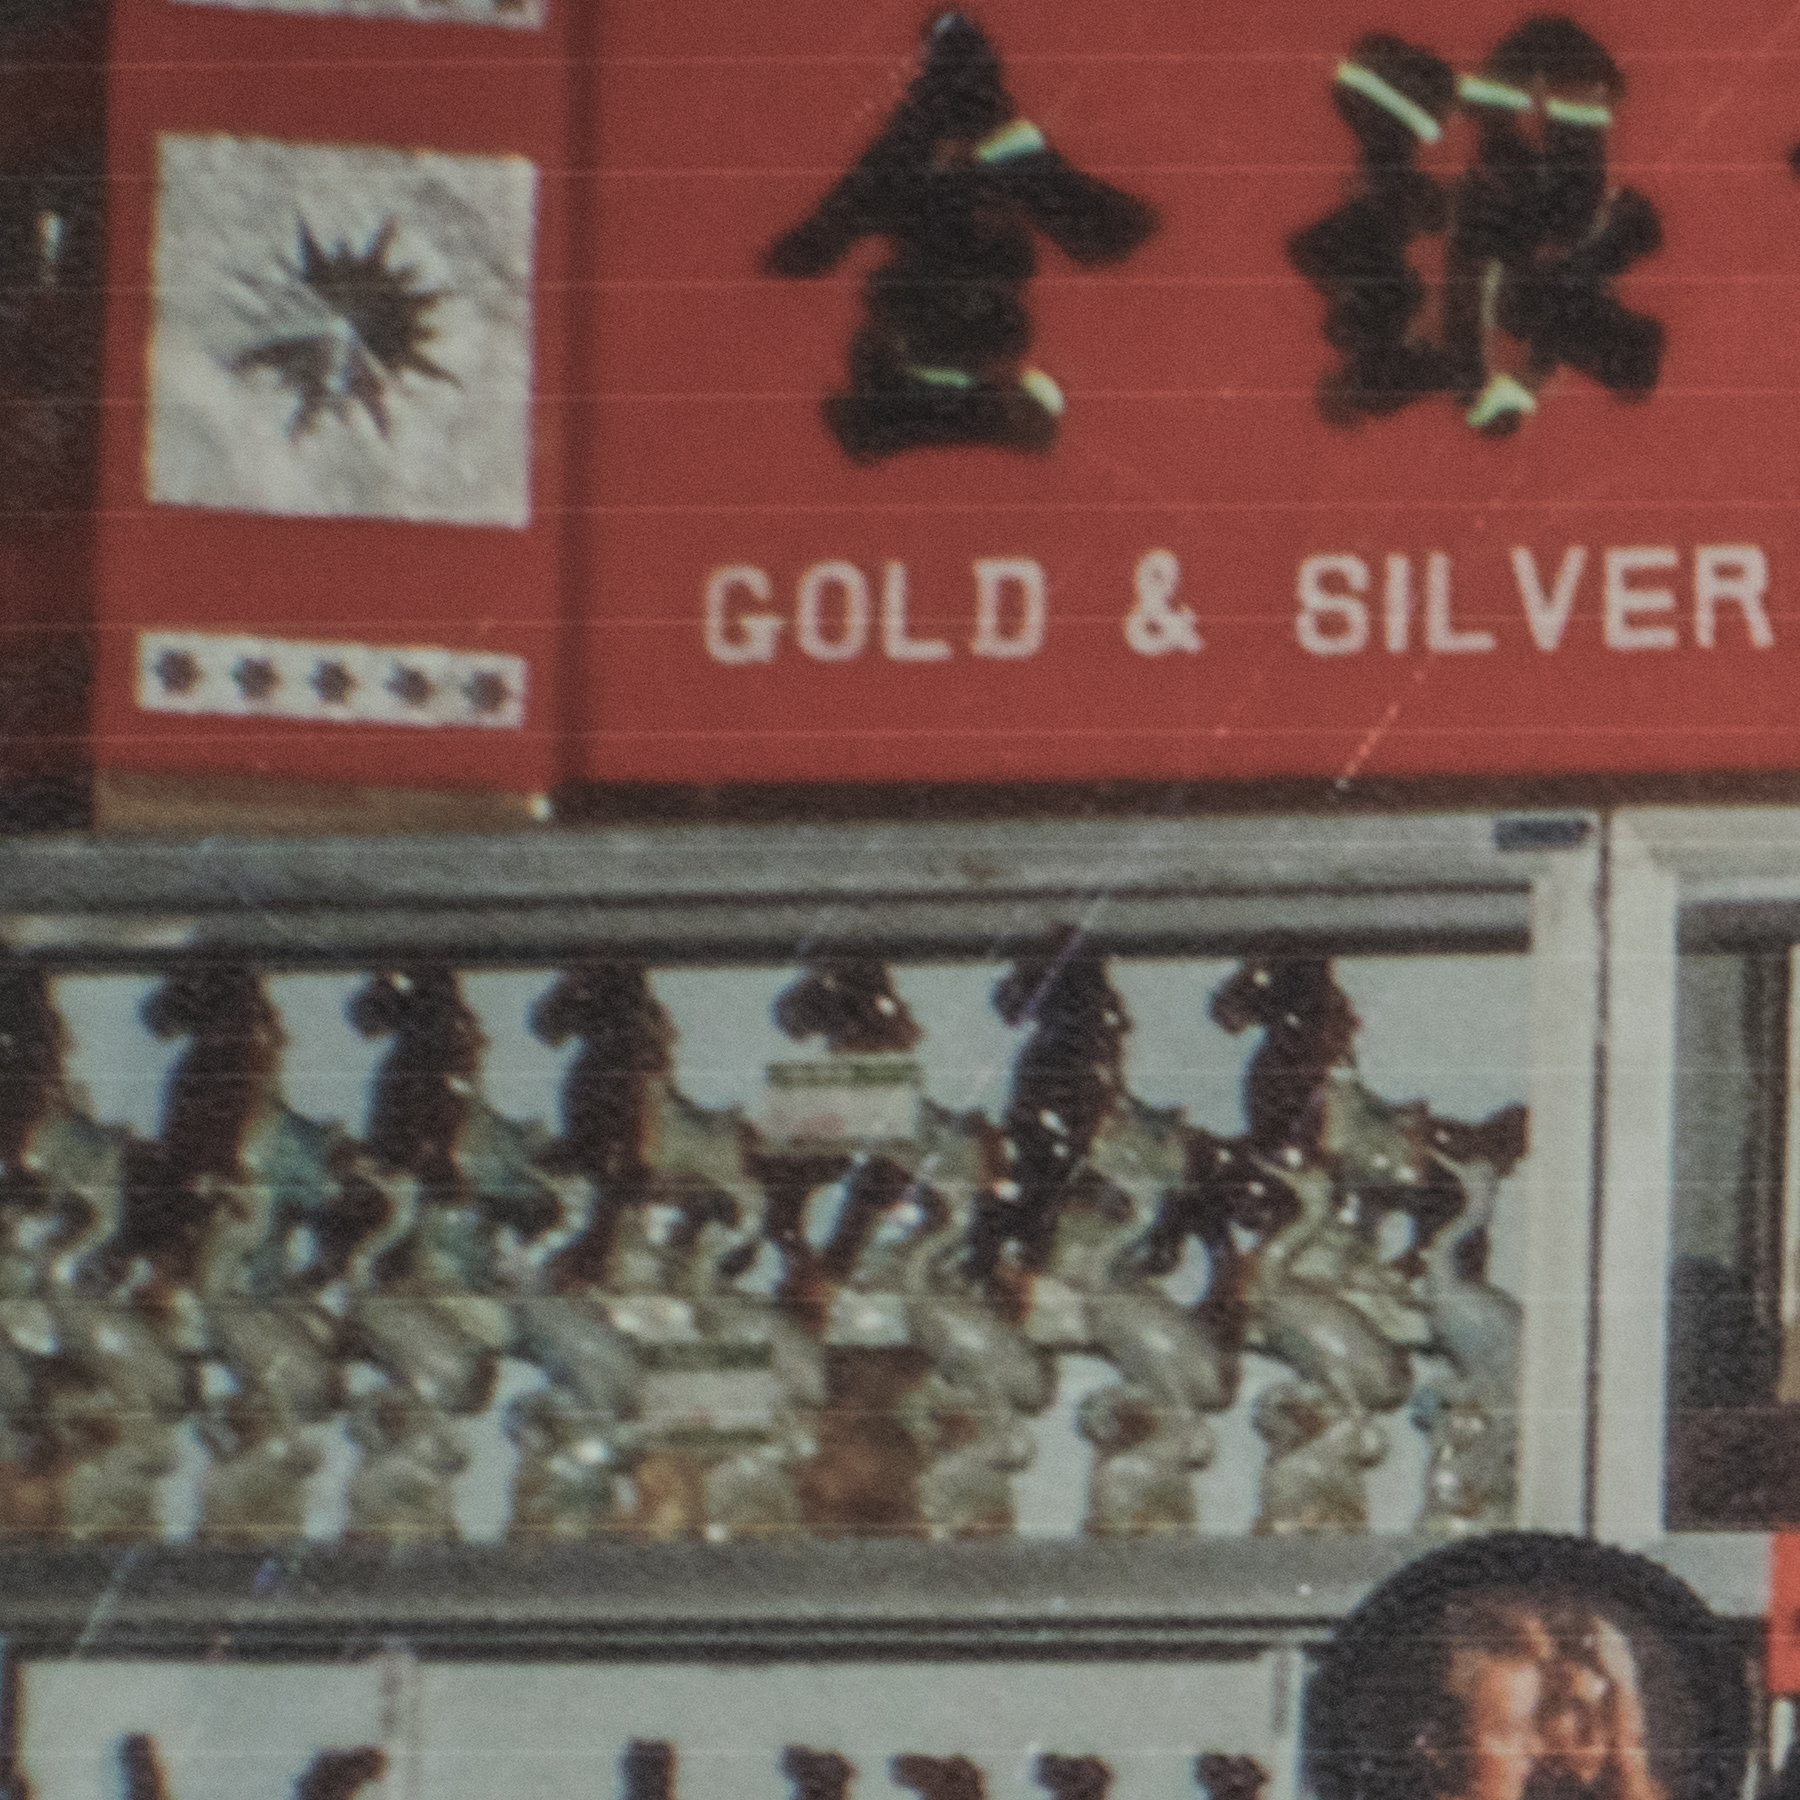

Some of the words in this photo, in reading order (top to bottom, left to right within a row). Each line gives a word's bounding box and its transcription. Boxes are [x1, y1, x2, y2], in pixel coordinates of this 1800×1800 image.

[703, 559, 1047, 664] GOLD
[1124, 548, 1203, 658] &
[1294, 545, 1775, 655] SILVER
